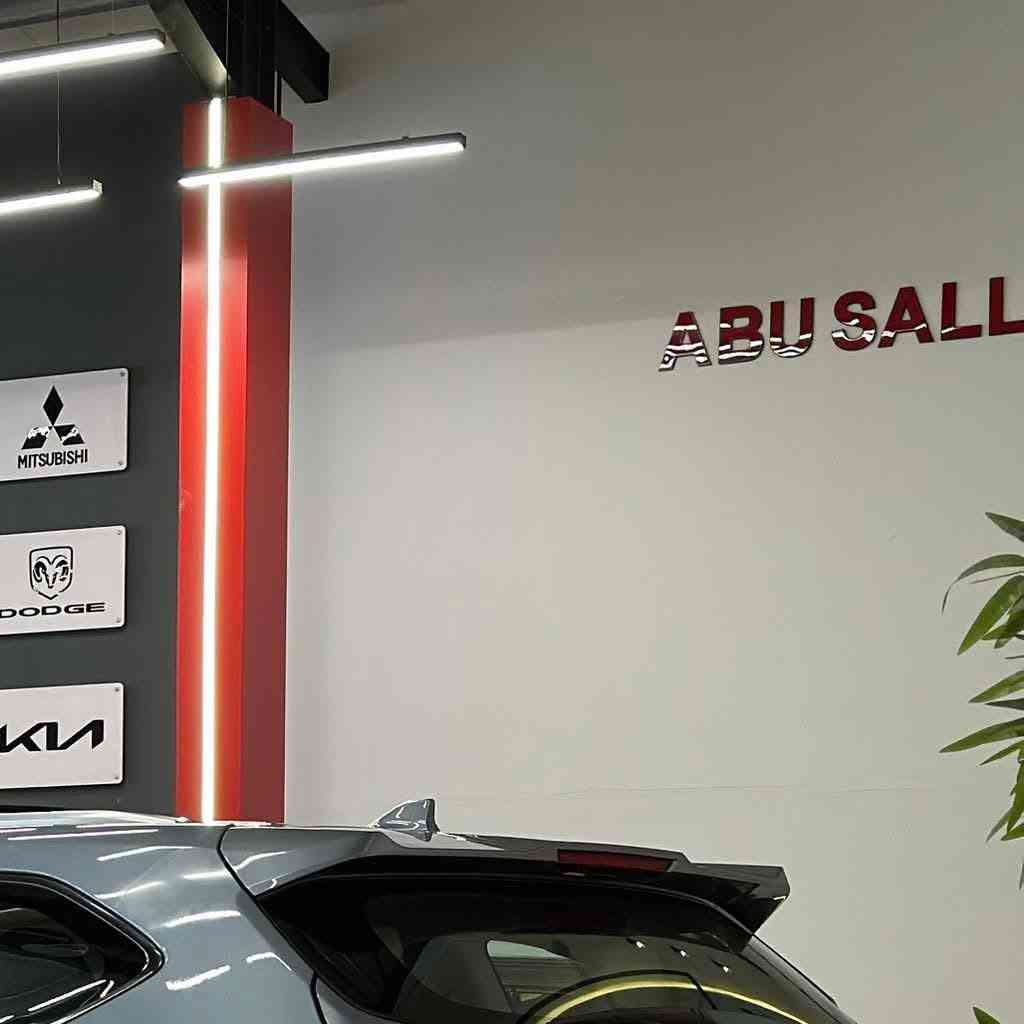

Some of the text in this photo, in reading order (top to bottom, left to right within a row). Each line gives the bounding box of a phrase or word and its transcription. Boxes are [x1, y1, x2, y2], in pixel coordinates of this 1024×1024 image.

[658, 276, 1024, 372] ABU SALL
[17, 447, 89, 470] MITSUBISHI
